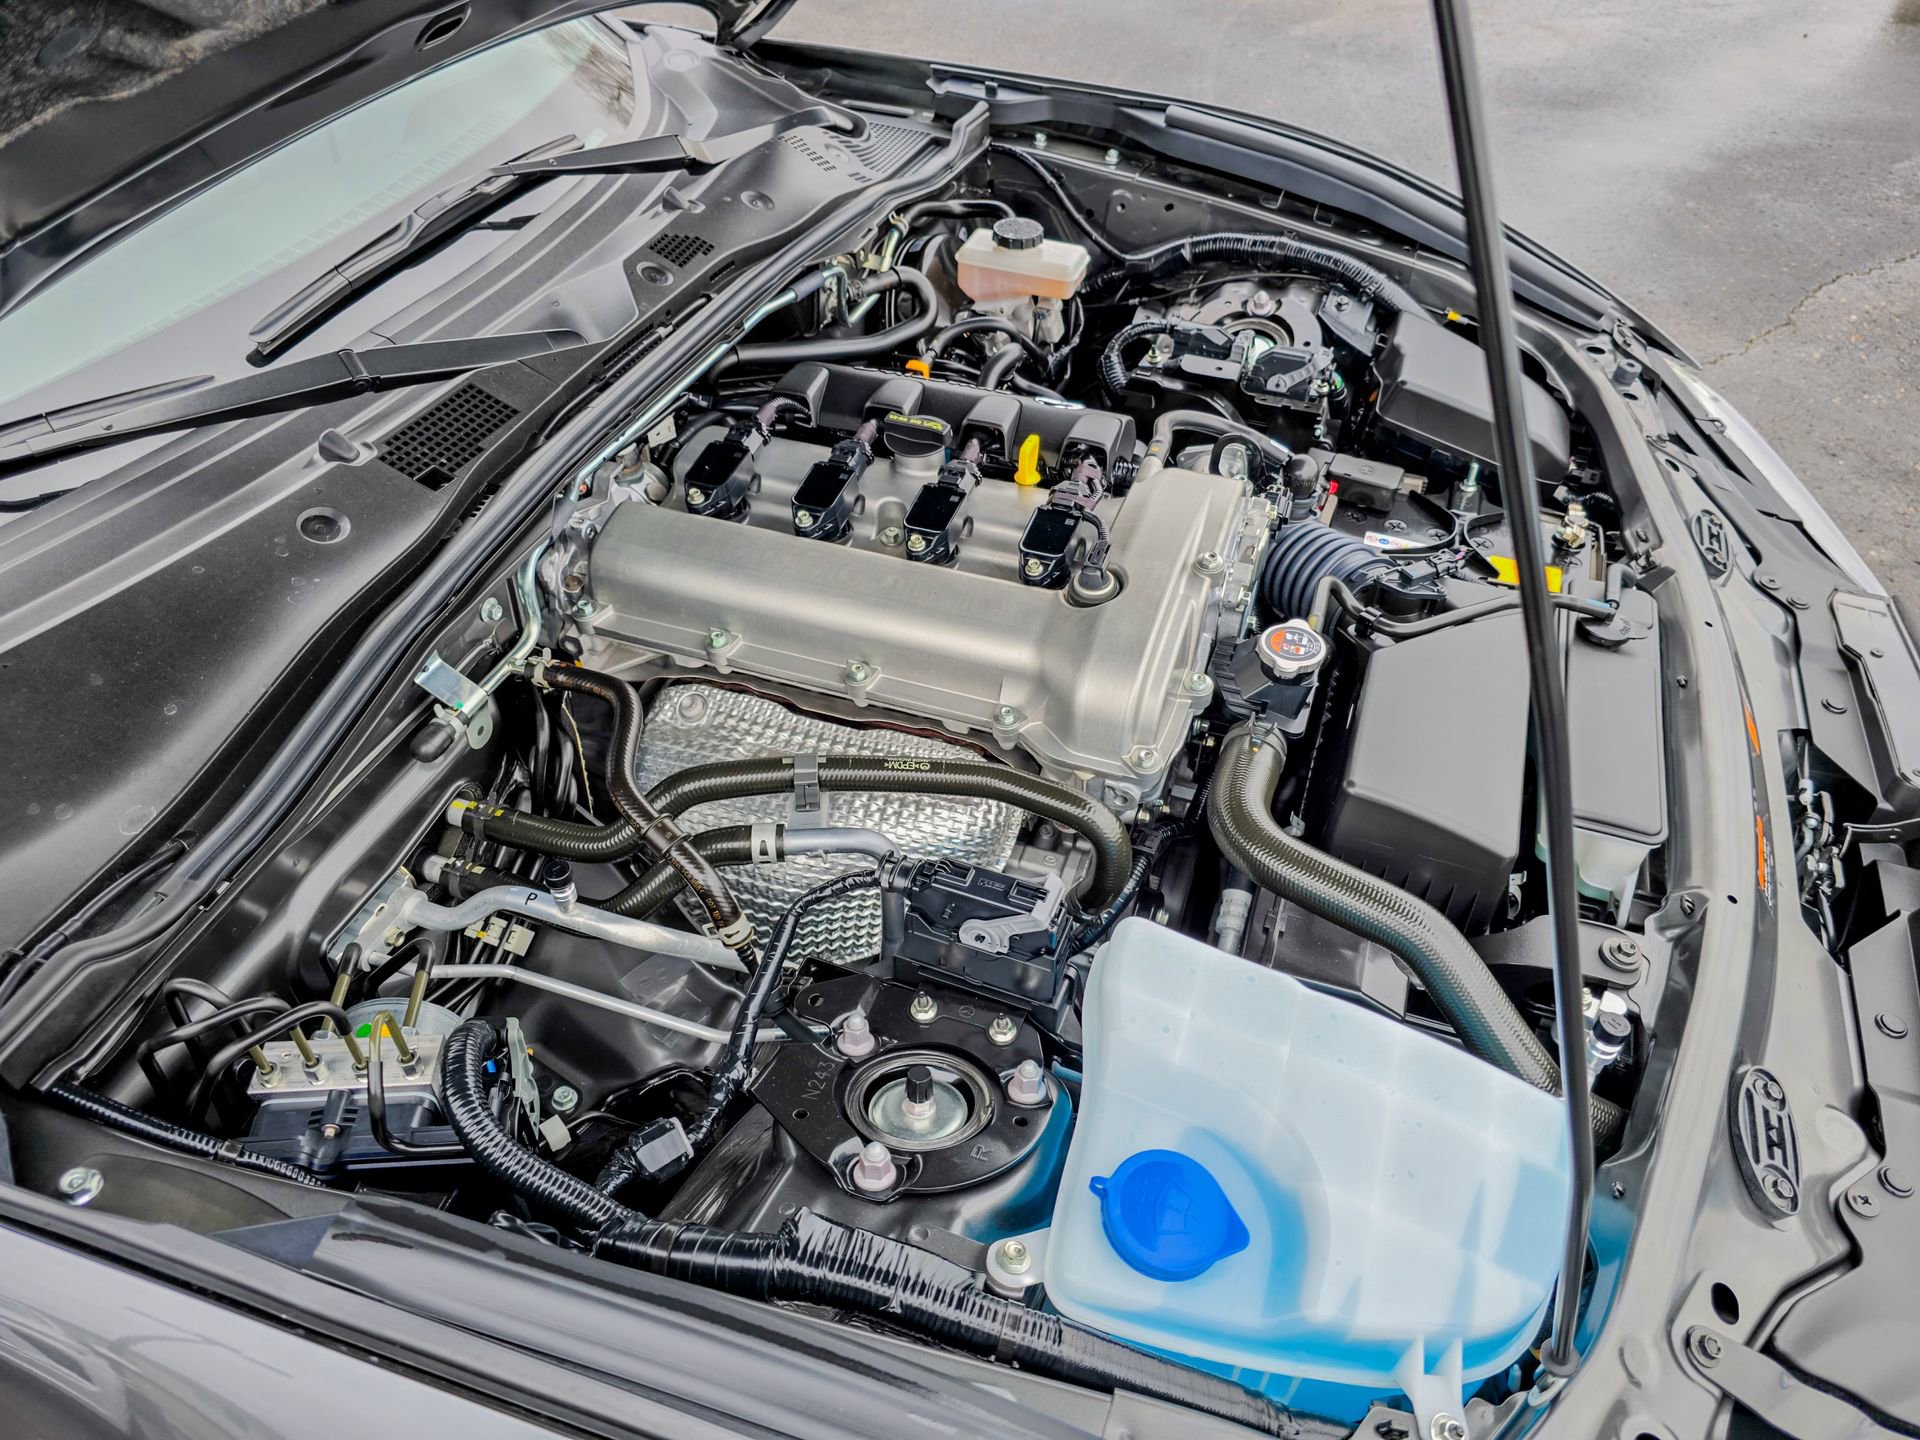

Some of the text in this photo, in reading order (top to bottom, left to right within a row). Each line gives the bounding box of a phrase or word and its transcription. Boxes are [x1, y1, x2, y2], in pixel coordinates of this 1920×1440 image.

[525, 892, 538, 905] P
[801, 1061, 835, 1100] N243
[970, 1144, 989, 1161] R
